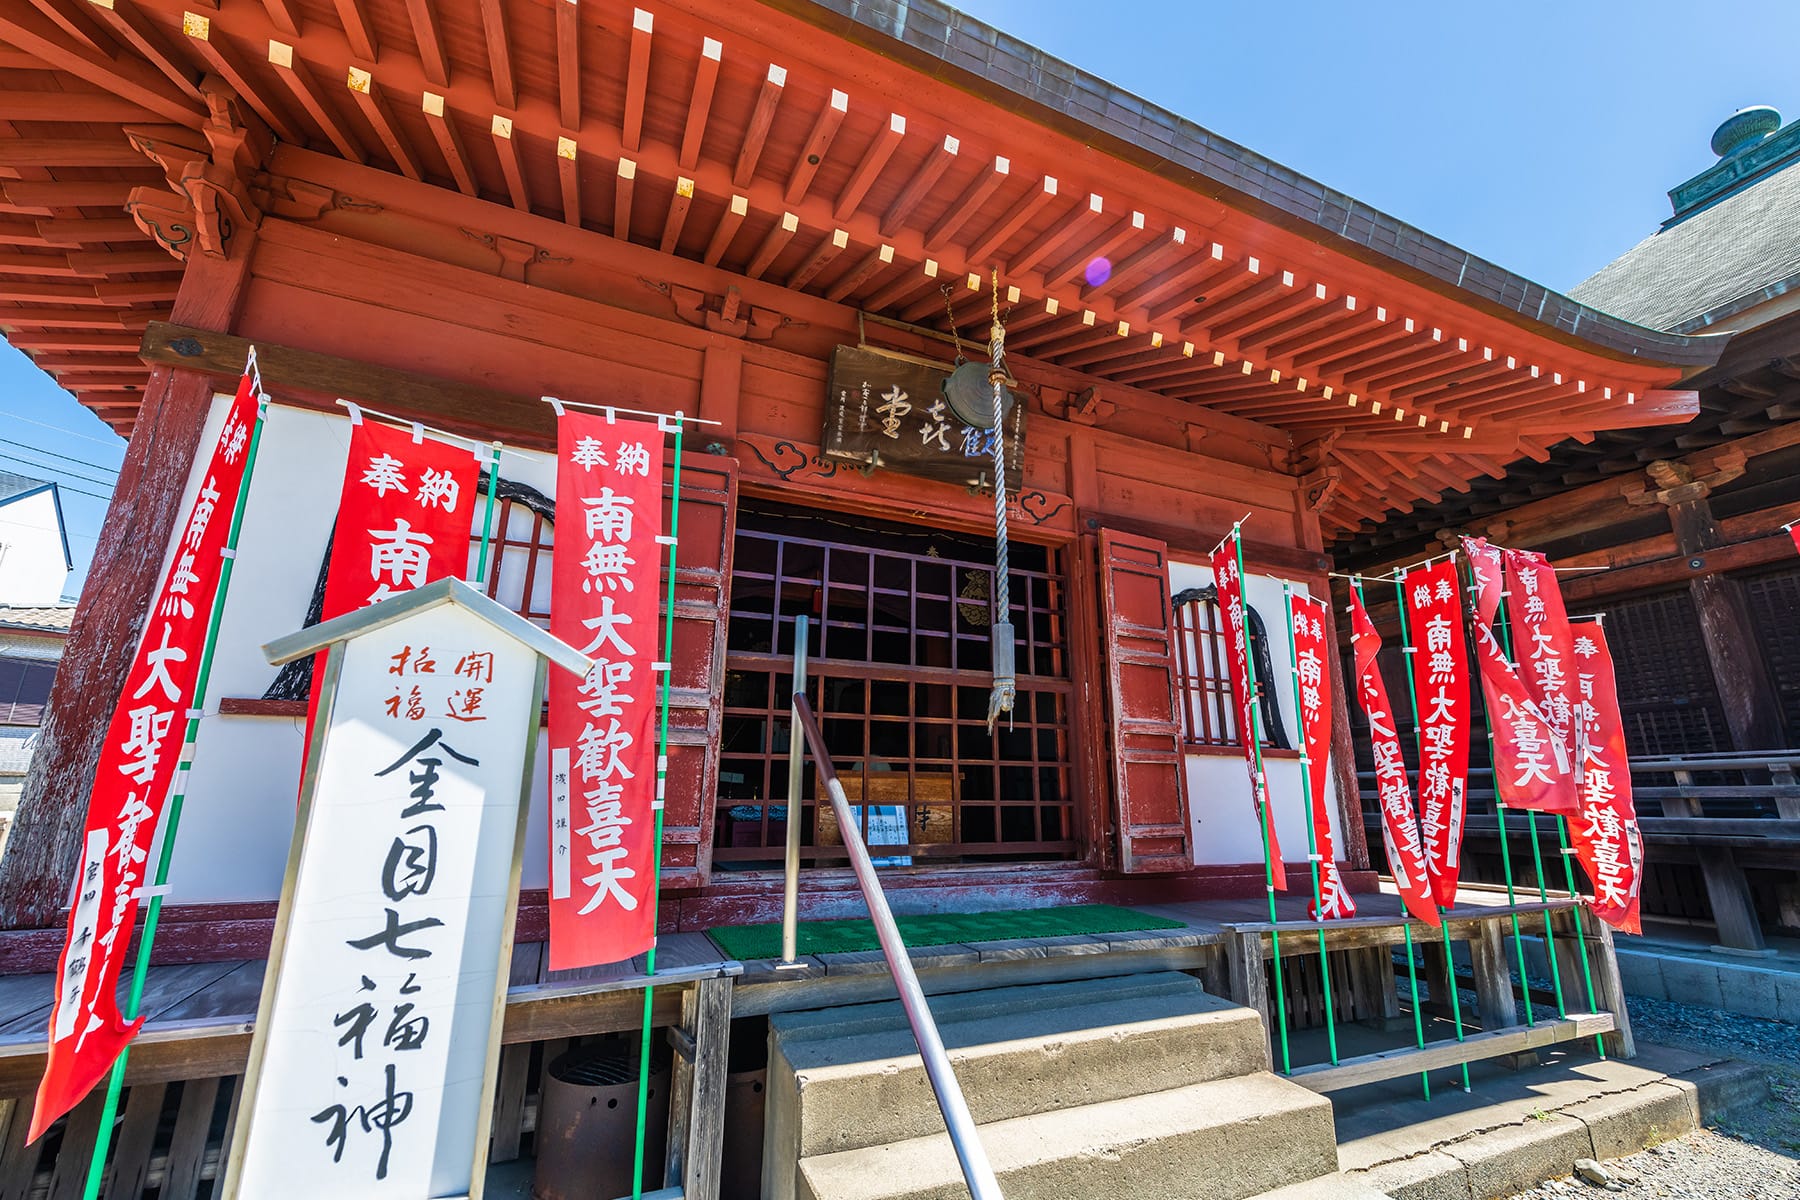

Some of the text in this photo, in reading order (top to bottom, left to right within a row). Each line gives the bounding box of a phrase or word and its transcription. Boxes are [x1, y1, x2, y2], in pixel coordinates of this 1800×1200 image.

[360, 452, 460, 514] 奉納
[571, 435, 650, 478] 奉納
[384, 645, 436, 720] 招福
[445, 650, 494, 722] 開運
[573, 487, 637, 915] 南無大聖歓喜天
[310, 727, 480, 1181] 金目七福神
